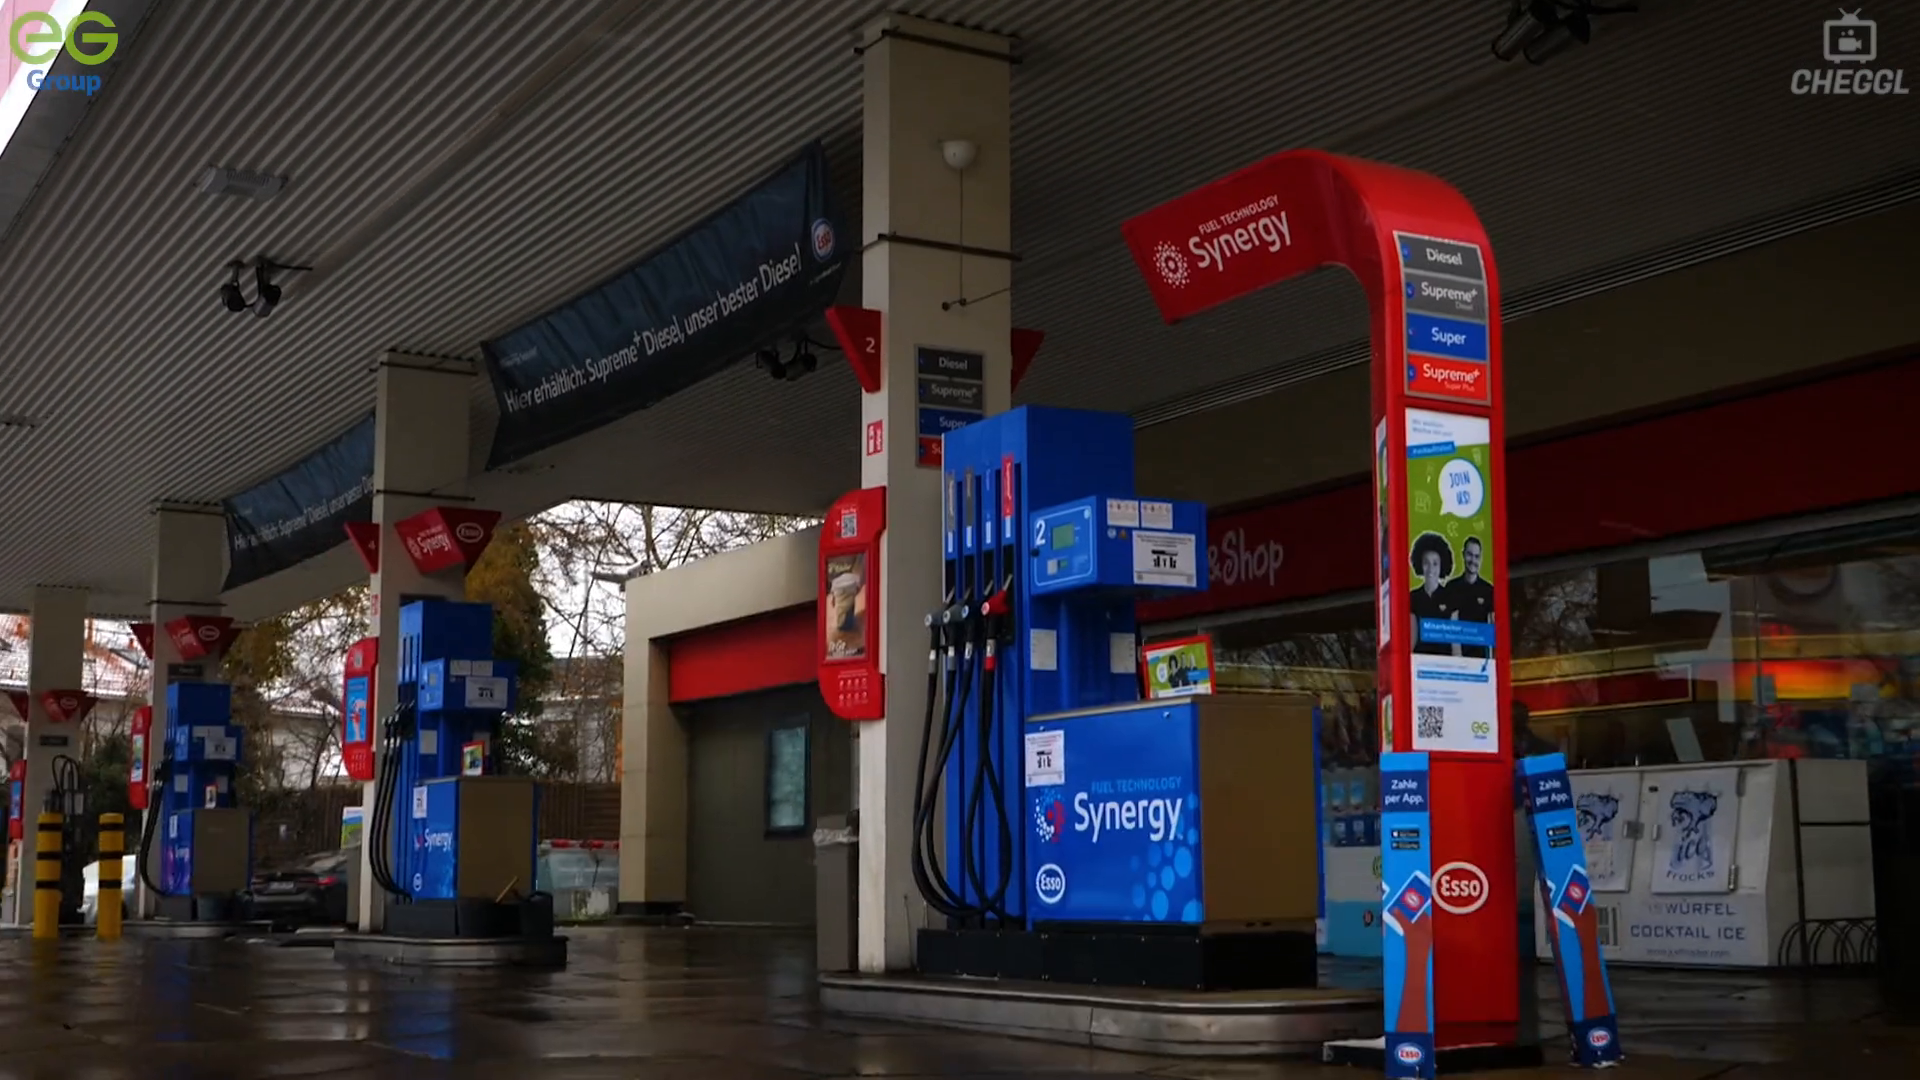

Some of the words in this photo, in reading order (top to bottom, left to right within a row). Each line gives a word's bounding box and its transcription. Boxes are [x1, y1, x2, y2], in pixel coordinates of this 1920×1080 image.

[1198, 219, 1221, 235] FUEL
[1220, 194, 1279, 226] TECHNOLOGY
[1188, 210, 1292, 273] Synergy
[1425, 247, 1463, 266] Diesel
[503, 388, 533, 414] Hier
[533, 364, 587, 405] erhältlich:
[641, 314, 685, 356] Diesel,
[684, 301, 719, 336] unser
[716, 275, 760, 318] bester
[758, 241, 803, 294] Diesel
[1431, 326, 1467, 347] Super
[865, 337, 876, 354] 2
[938, 356, 968, 370] Diesel
[938, 416, 967, 432] Super
[1449, 470, 1471, 489] JOIN
[1035, 519, 1046, 546] 2
[416, 533, 453, 556] Synergy
[1091, 781, 1114, 794] FUEL
[1116, 776, 1182, 793] TECHNOLOGY
[1391, 780, 1418, 790] Zahle
[1538, 779, 1561, 791] Zahle
[1384, 794, 1400, 804] per
[1402, 793, 1424, 806] App.
[1535, 796, 1549, 807] per
[1074, 792, 1183, 843] Synergy
[424, 828, 453, 853] Synergy
[1040, 874, 1061, 891] Esso
[1440, 876, 1481, 897] Esso
[1666, 899, 1737, 915] WÜRFEL
[1630, 925, 1711, 939] COCKTAIL
[1718, 927, 1746, 940] ICE
[1399, 1048, 1421, 1060] Esso
